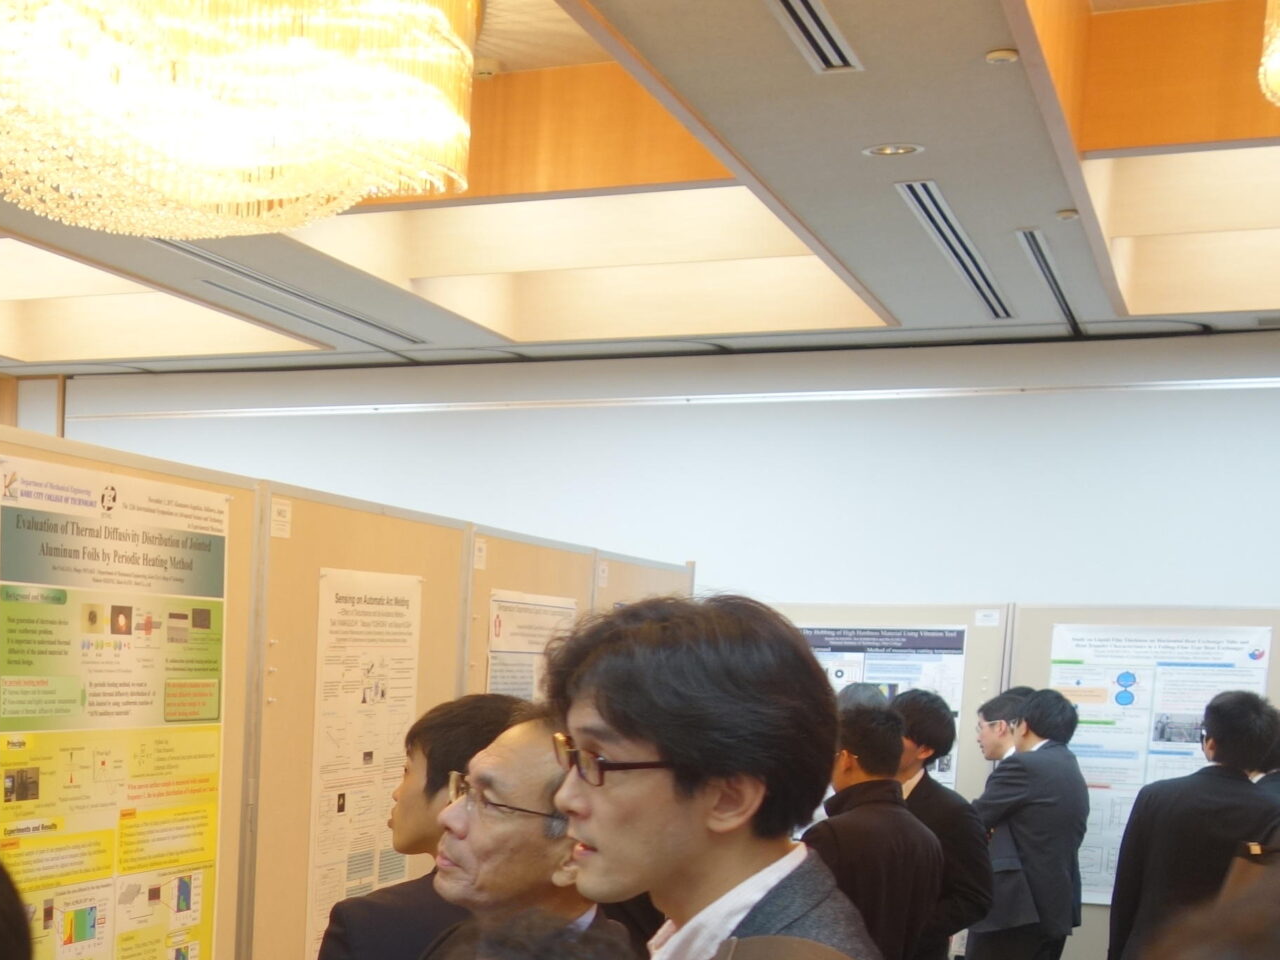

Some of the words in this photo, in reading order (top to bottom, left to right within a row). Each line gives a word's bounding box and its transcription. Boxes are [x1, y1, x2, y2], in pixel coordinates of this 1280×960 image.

[16, 514, 59, 534] Evaluation
[60, 520, 69, 536] of
[69, 521, 102, 539] Thermal
[104, 526, 140, 547] Diffusivity
[142, 531, 180, 549] Distribution
[181, 537, 189, 550] of
[40, 542, 80, 560] Aluminum
[82, 546, 100, 561] Foils
[102, 549, 111, 566] by
[113, 550, 140, 566] Periodic
[142, 553, 168, 572] Heating
[169, 556, 193, 571] Method
[335, 593, 355, 607] Sensing
[357, 597, 363, 605] on
[363, 594, 386, 606] Automatic
[394, 596, 410, 610] Welding
[7, 740, 26, 749] Principle
[4, 826, 31, 837] Experiments
[41, 823, 57, 832] Results
